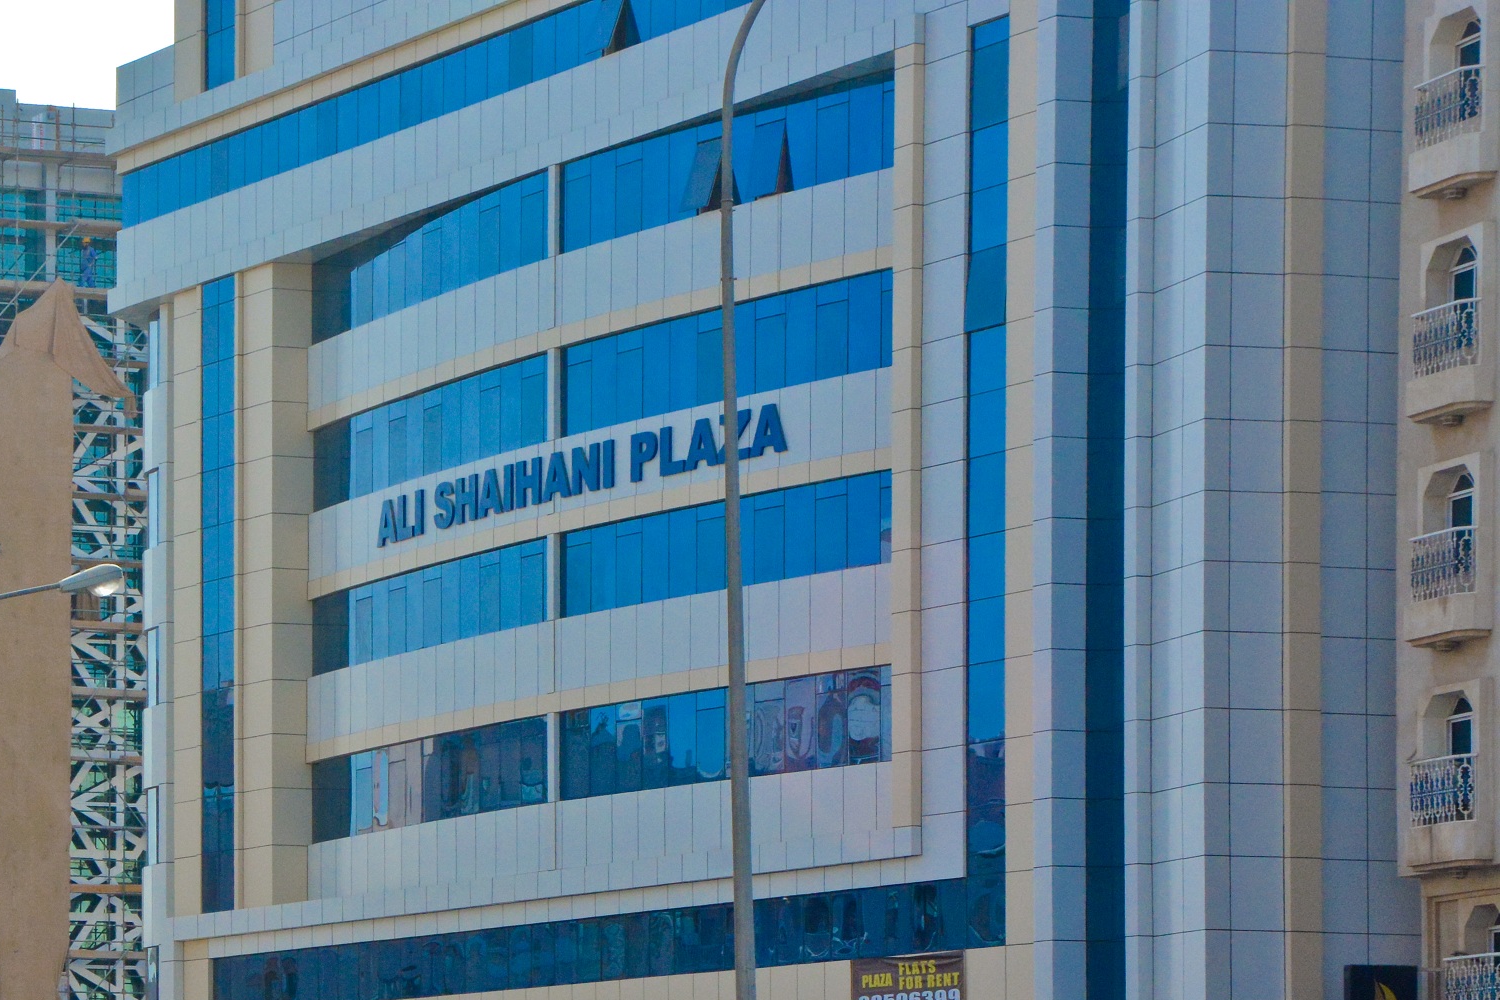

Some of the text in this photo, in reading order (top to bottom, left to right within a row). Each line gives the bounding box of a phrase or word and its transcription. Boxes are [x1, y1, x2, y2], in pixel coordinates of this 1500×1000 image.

[376, 402, 788, 548] ALI SHAIHANI PLAZA
[898, 960, 937, 976] FLATS
[861, 973, 893, 988] PLAZA
[898, 972, 960, 990] FOR RENT
